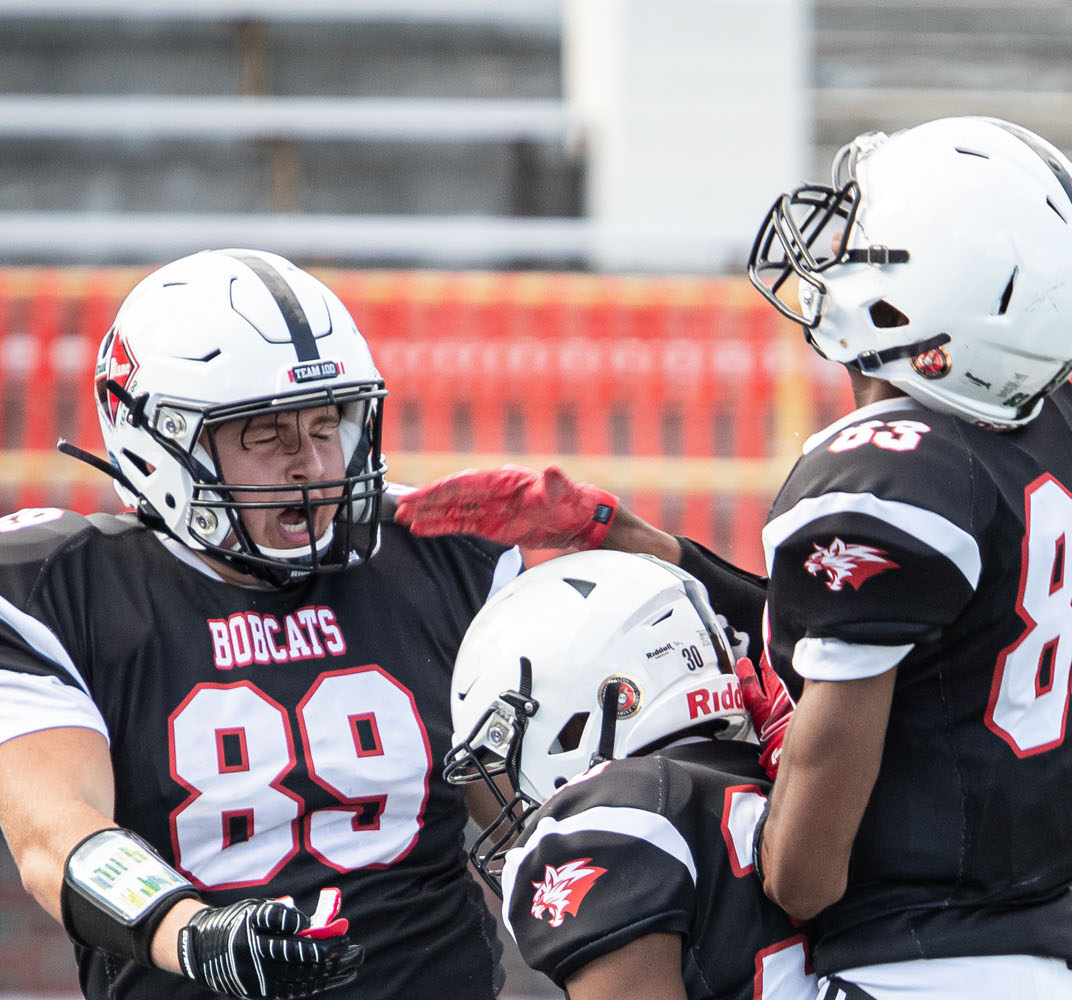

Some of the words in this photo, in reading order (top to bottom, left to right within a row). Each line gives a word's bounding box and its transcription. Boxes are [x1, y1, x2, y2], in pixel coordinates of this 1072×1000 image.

[295, 365, 320, 380] TEAM
[321, 363, 336, 375] 100
[827, 420, 931, 453] 83
[207, 606, 347, 670] BOBCATS
[682, 645, 704, 671] 30
[687, 682, 743, 720] Ridd
[168, 664, 433, 892] 89
